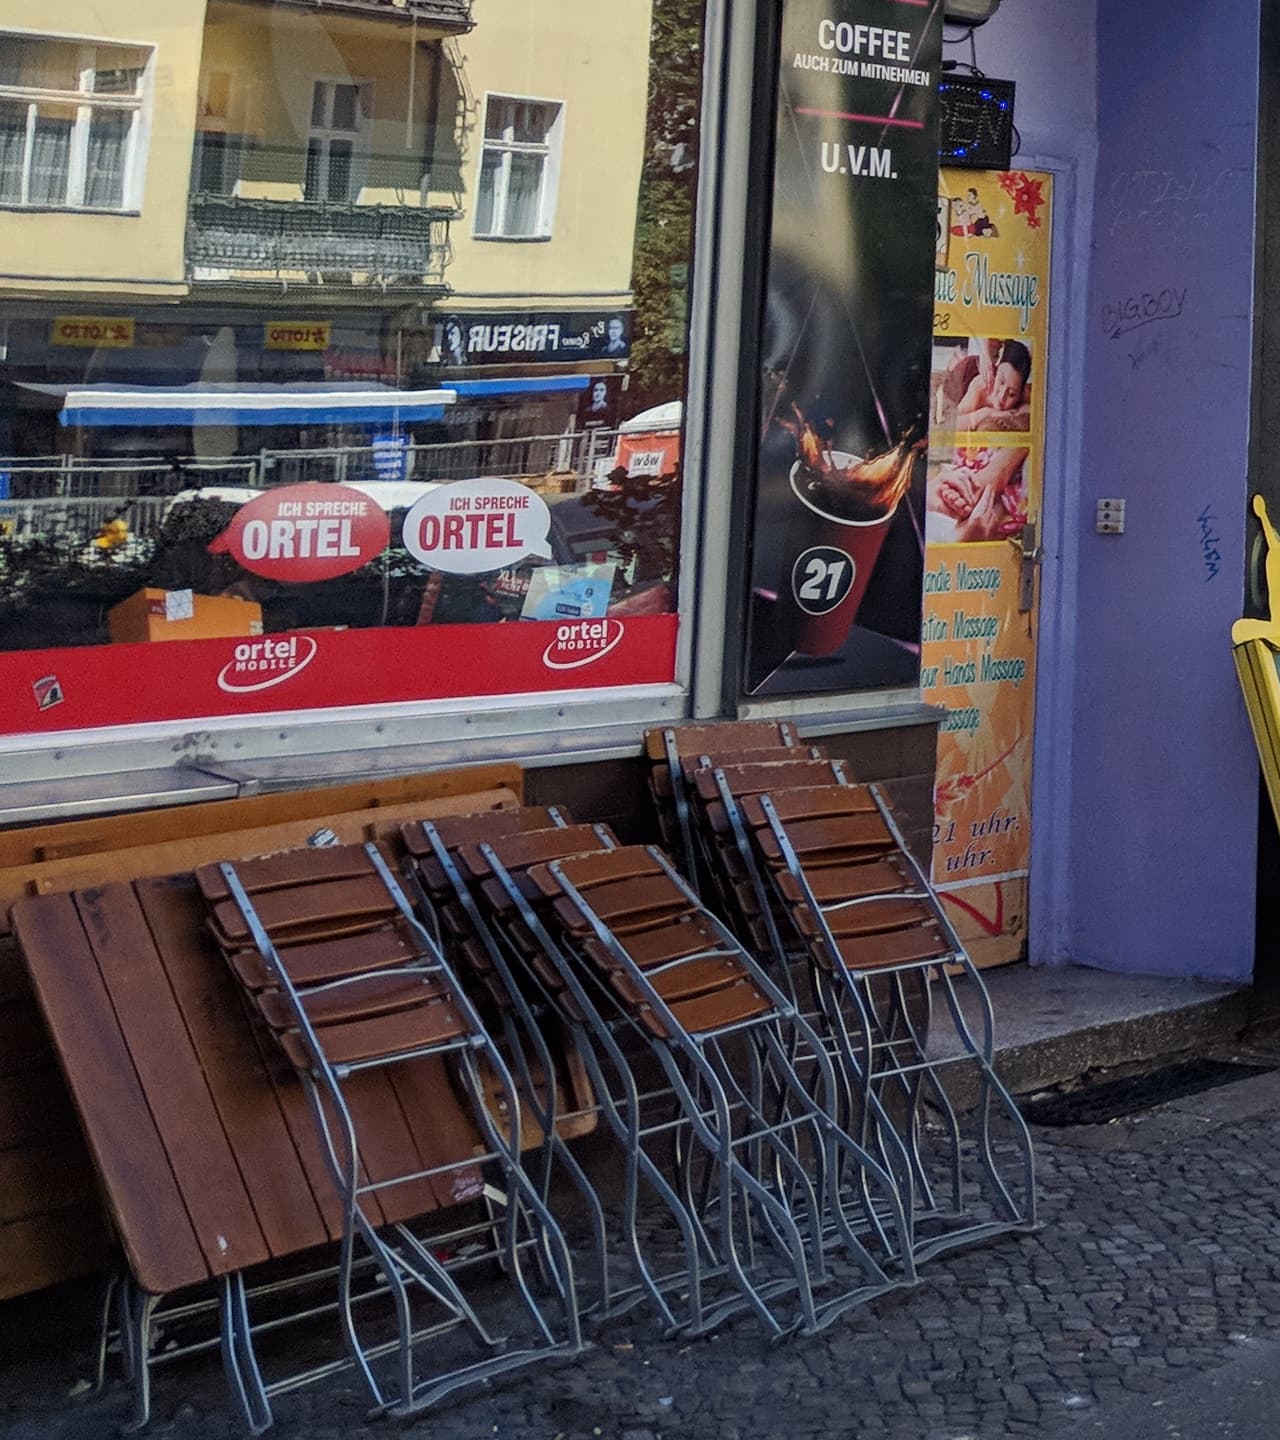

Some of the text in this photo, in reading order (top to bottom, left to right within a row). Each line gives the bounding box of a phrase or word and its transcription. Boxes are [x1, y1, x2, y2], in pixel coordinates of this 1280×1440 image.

[818, 19, 911, 61] COFFEE
[793, 53, 930, 87] AUCH ZUM MITNEHMEN
[821, 142, 898, 179] U.V.M.
[963, 252, 1040, 332] Massage
[278, 501, 368, 517] ICH SPRECHE
[450, 496, 530, 511] ICH SPRECHE
[242, 519, 361, 560] ORTEL
[418, 513, 524, 552] ORTEL
[799, 558, 846, 600] 21
[957, 563, 1000, 598] Massage
[556, 619, 608, 640] ortel
[557, 639, 607, 651] MOBILE
[953, 611, 998, 645] Massage
[234, 636, 297, 661] ortel
[235, 658, 297, 672] MOBILE
[921, 657, 1026, 690] our Hands Massage
